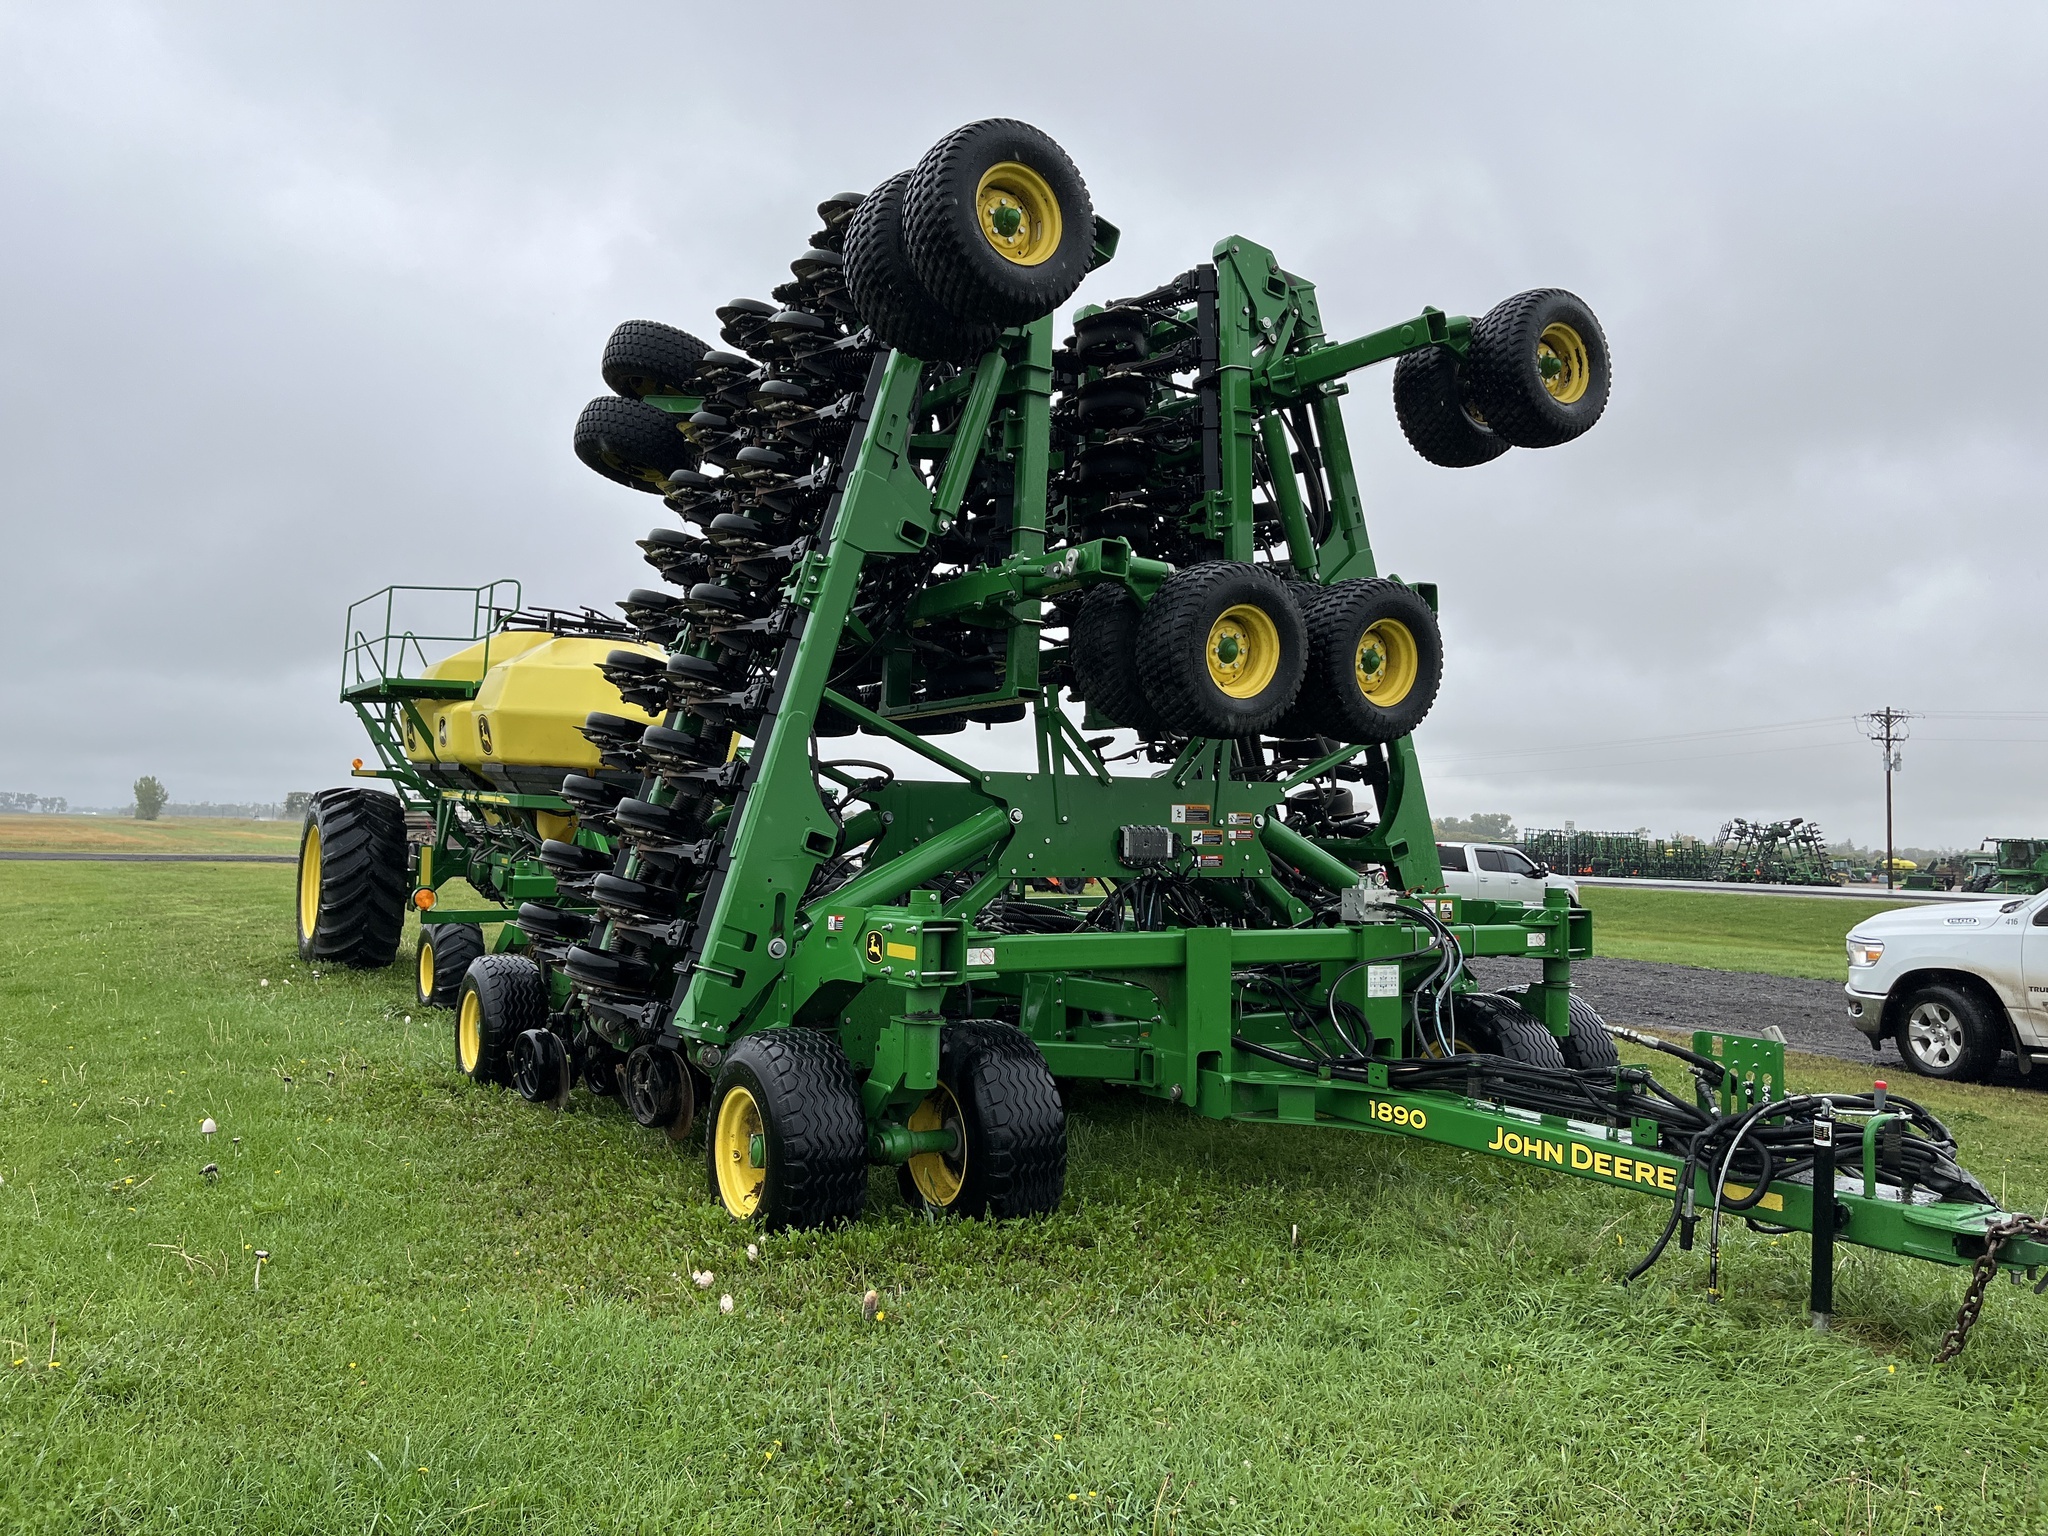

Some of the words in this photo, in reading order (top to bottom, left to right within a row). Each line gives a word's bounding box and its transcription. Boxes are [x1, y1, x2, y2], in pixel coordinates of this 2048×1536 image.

[1369, 1099, 1427, 1130] 1890
[1488, 1126, 1564, 1165] JOHN
[1570, 1142, 1677, 1192] DEERE
